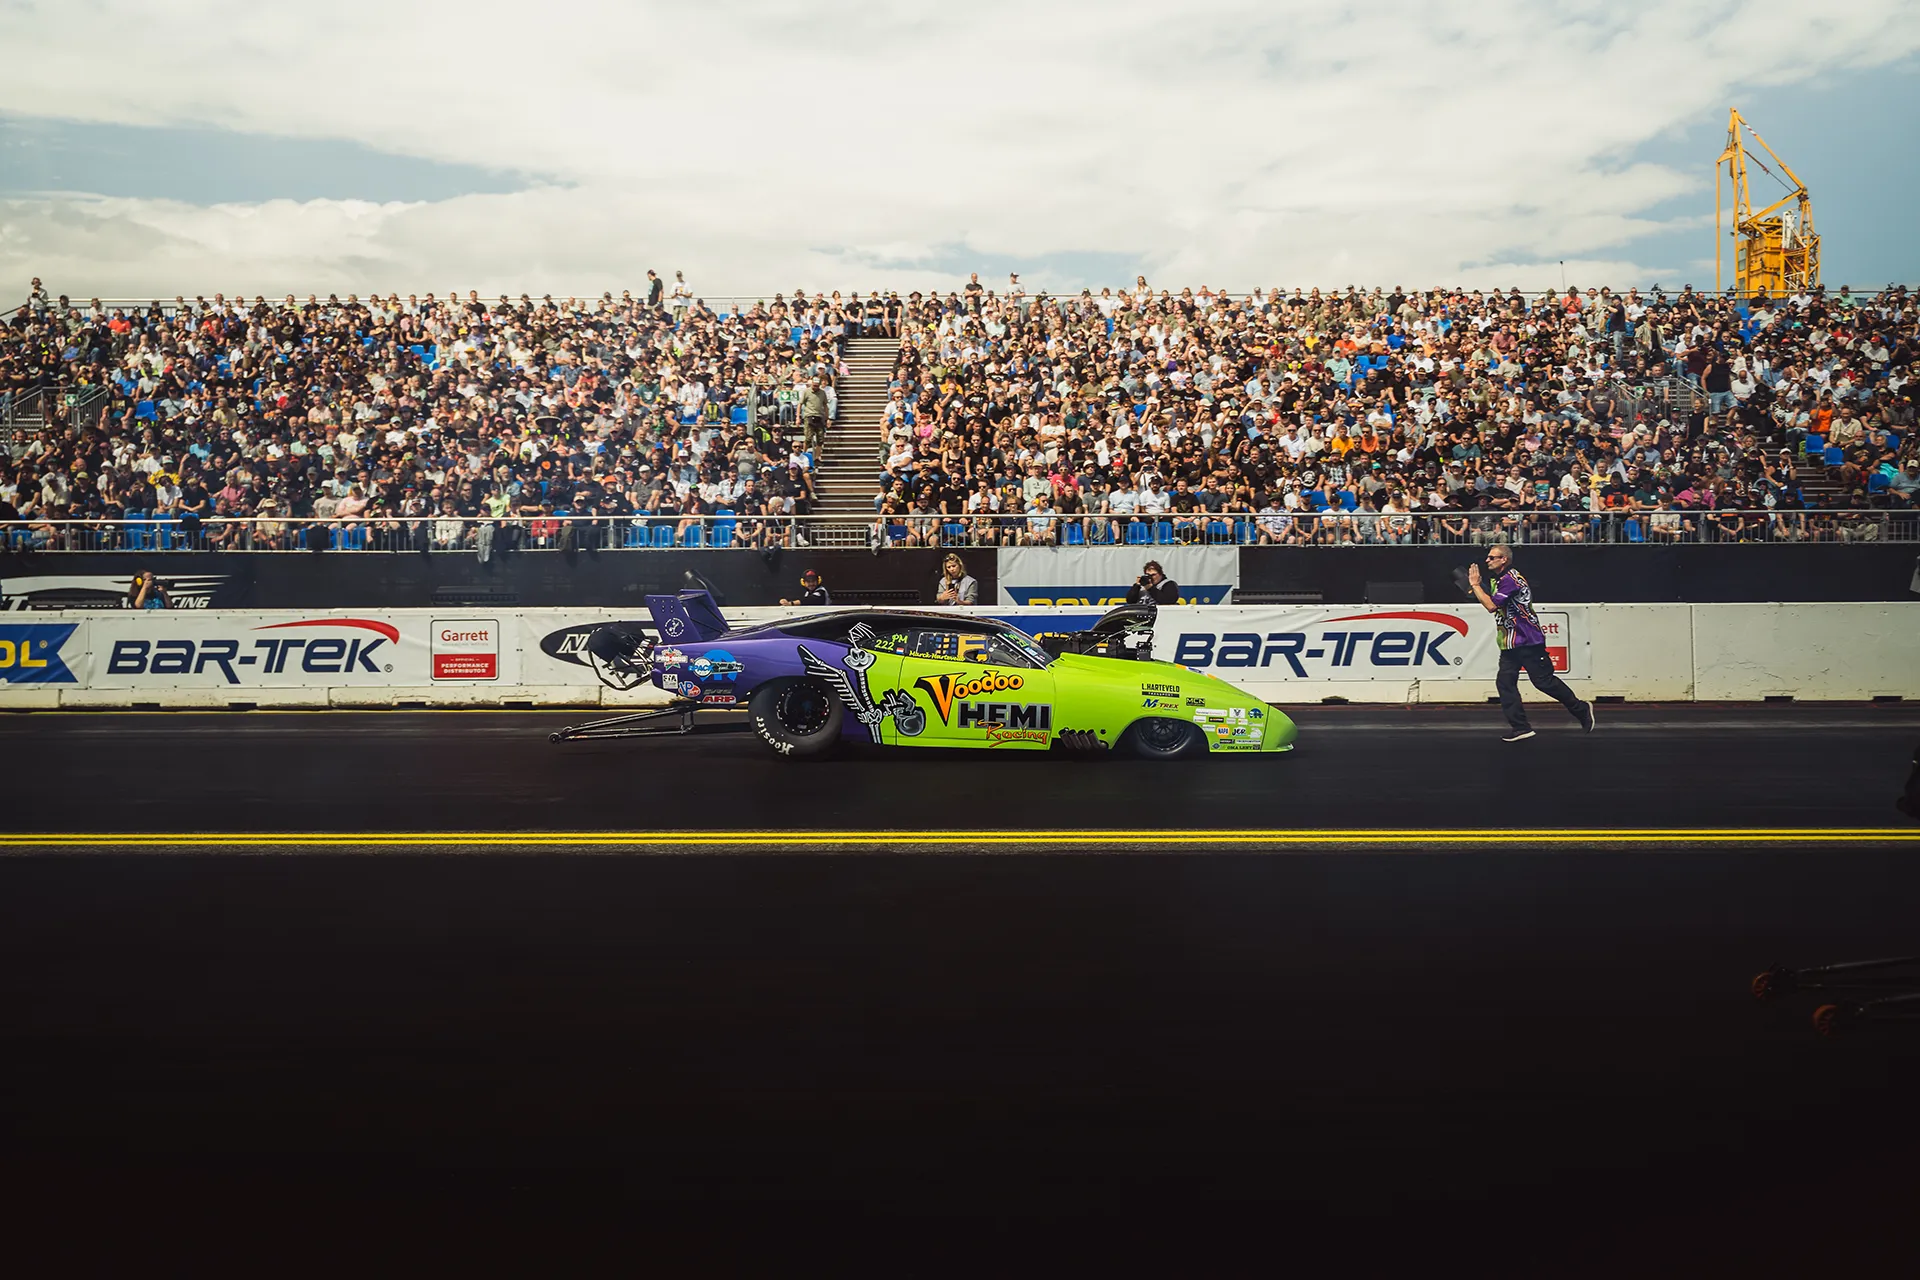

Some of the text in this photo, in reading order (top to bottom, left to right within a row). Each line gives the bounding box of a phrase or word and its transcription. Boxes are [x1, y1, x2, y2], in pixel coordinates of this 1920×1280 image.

[441, 629, 489, 642] Garrett
[875, 640, 894, 651] 222
[891, 633, 908, 644] PM
[703, 695, 735, 703] ARP
[913, 670, 1024, 727] Voodoo
[958, 700, 1052, 730] HEMI
[756, 716, 794, 755] Hoosier
[977, 720, 1048, 747] Racing
